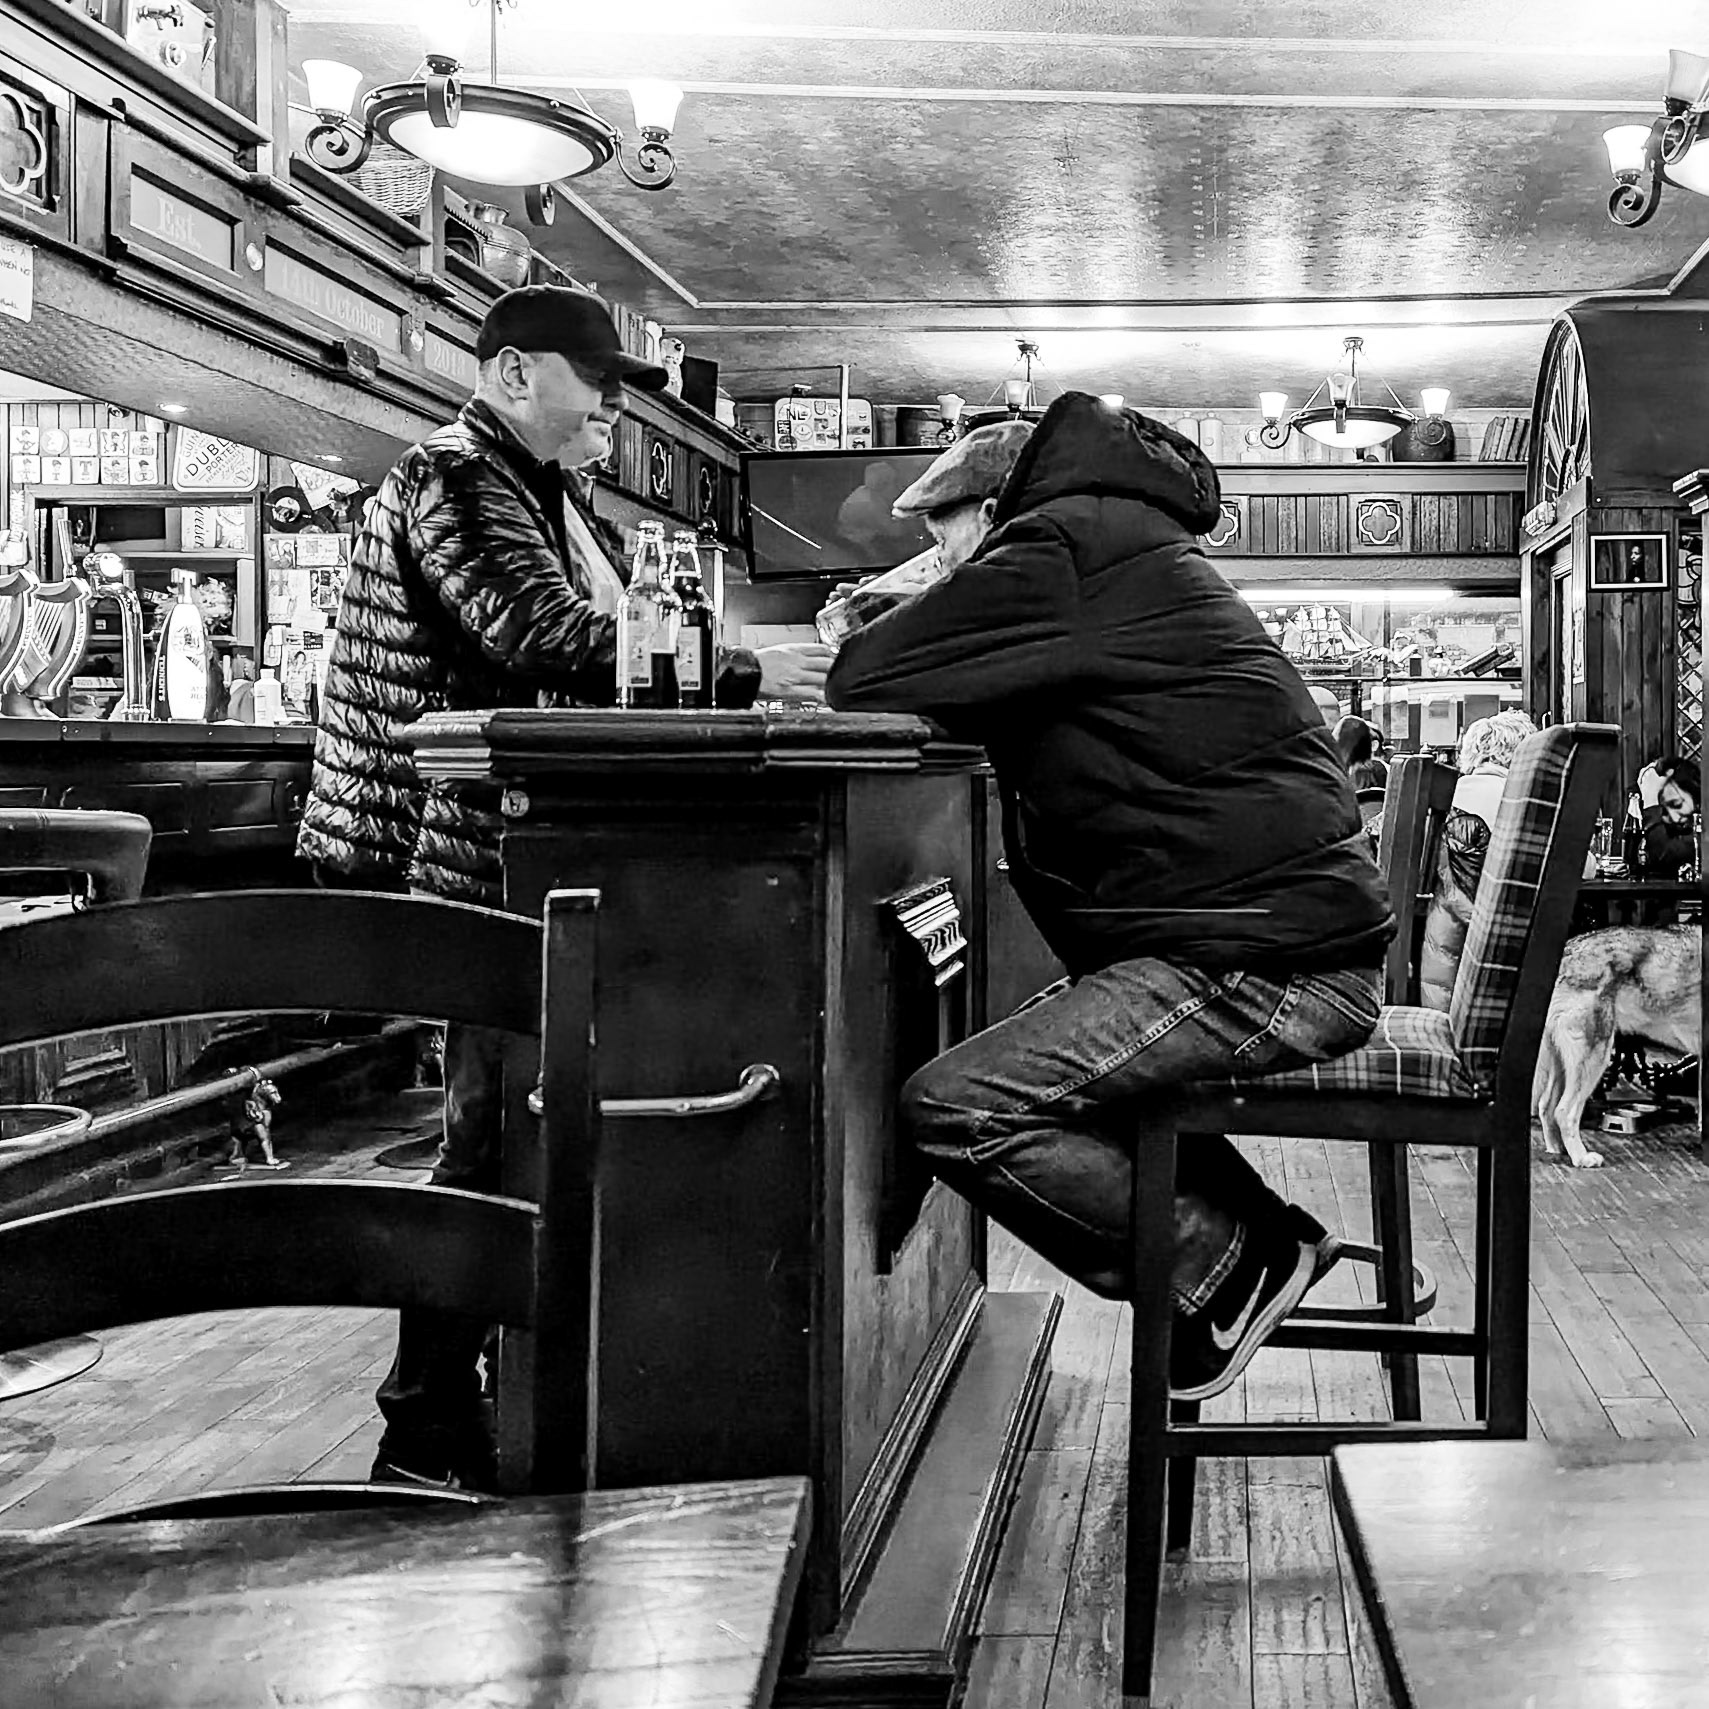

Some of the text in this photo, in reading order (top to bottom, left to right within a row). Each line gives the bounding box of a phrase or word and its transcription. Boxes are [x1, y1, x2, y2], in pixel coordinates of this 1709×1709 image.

[325, 284, 384, 339] October
[786, 407, 806, 421] NL
[183, 432, 200, 457] GUIN
[186, 438, 230, 476] DUBL
[205, 443, 240, 473] PORTER
[193, 506, 208, 548] weiser
